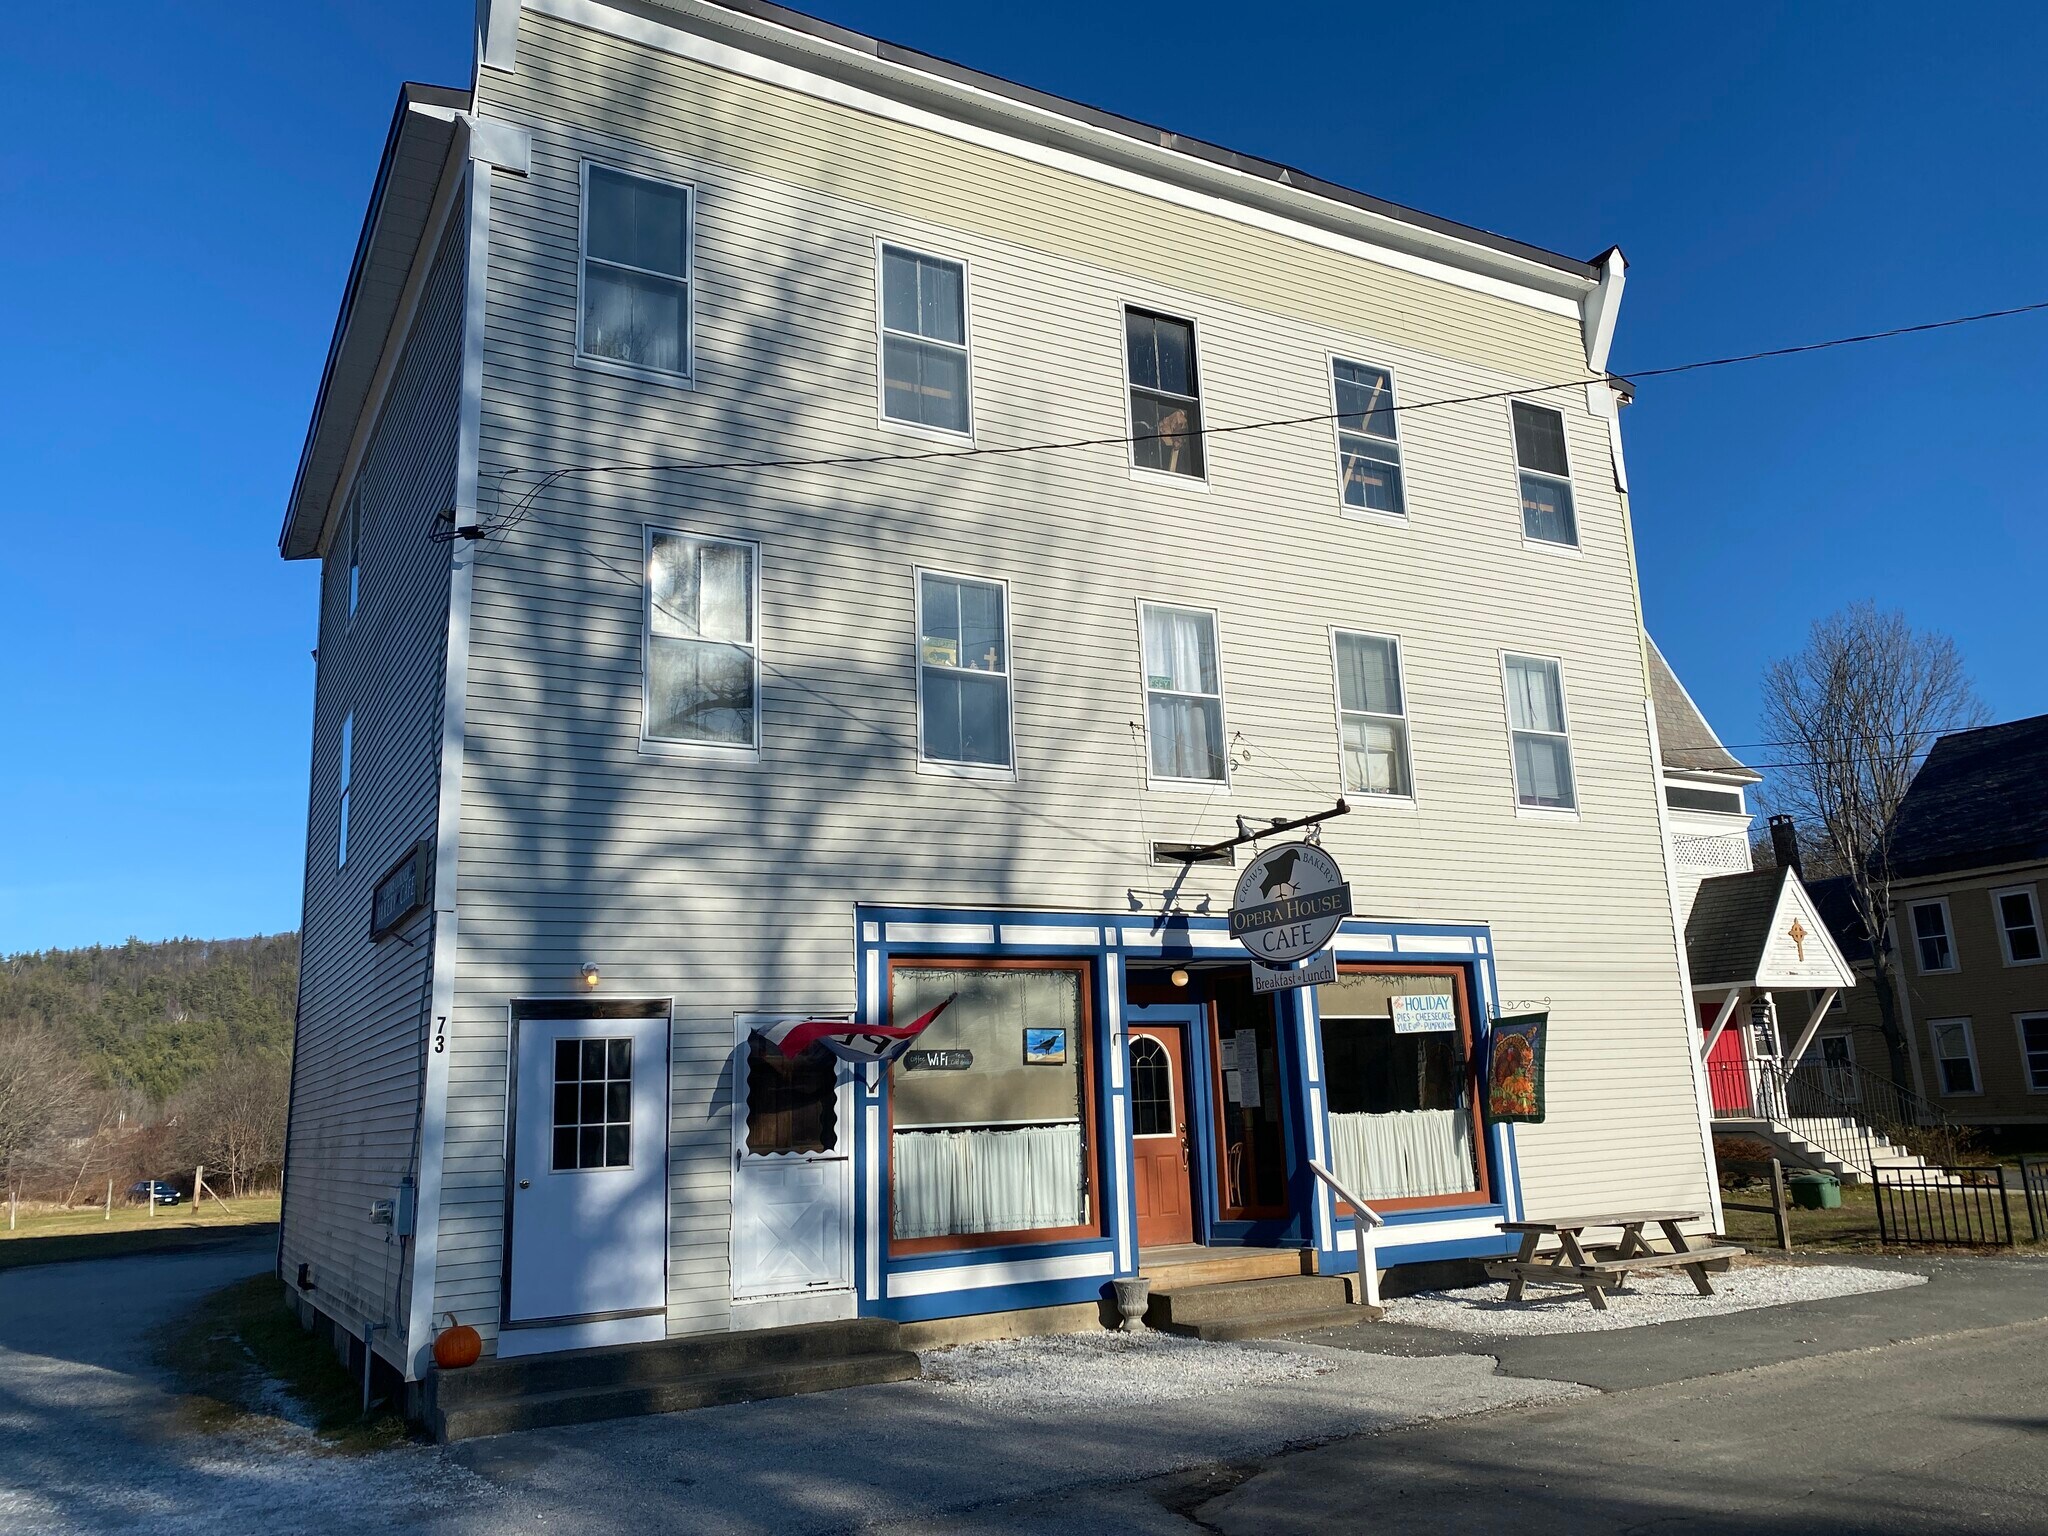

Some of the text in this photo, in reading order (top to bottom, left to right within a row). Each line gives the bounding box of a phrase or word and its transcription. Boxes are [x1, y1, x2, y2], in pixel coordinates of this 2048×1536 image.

[1240, 852, 1335, 903] CROWS BAKERY
[1234, 894, 1343, 930] OPERA HOUSE
[1263, 923, 1314, 952] CAFE
[1255, 965, 1331, 991] Breakfast Lunch
[1405, 996, 1449, 1011] HOLIDAY
